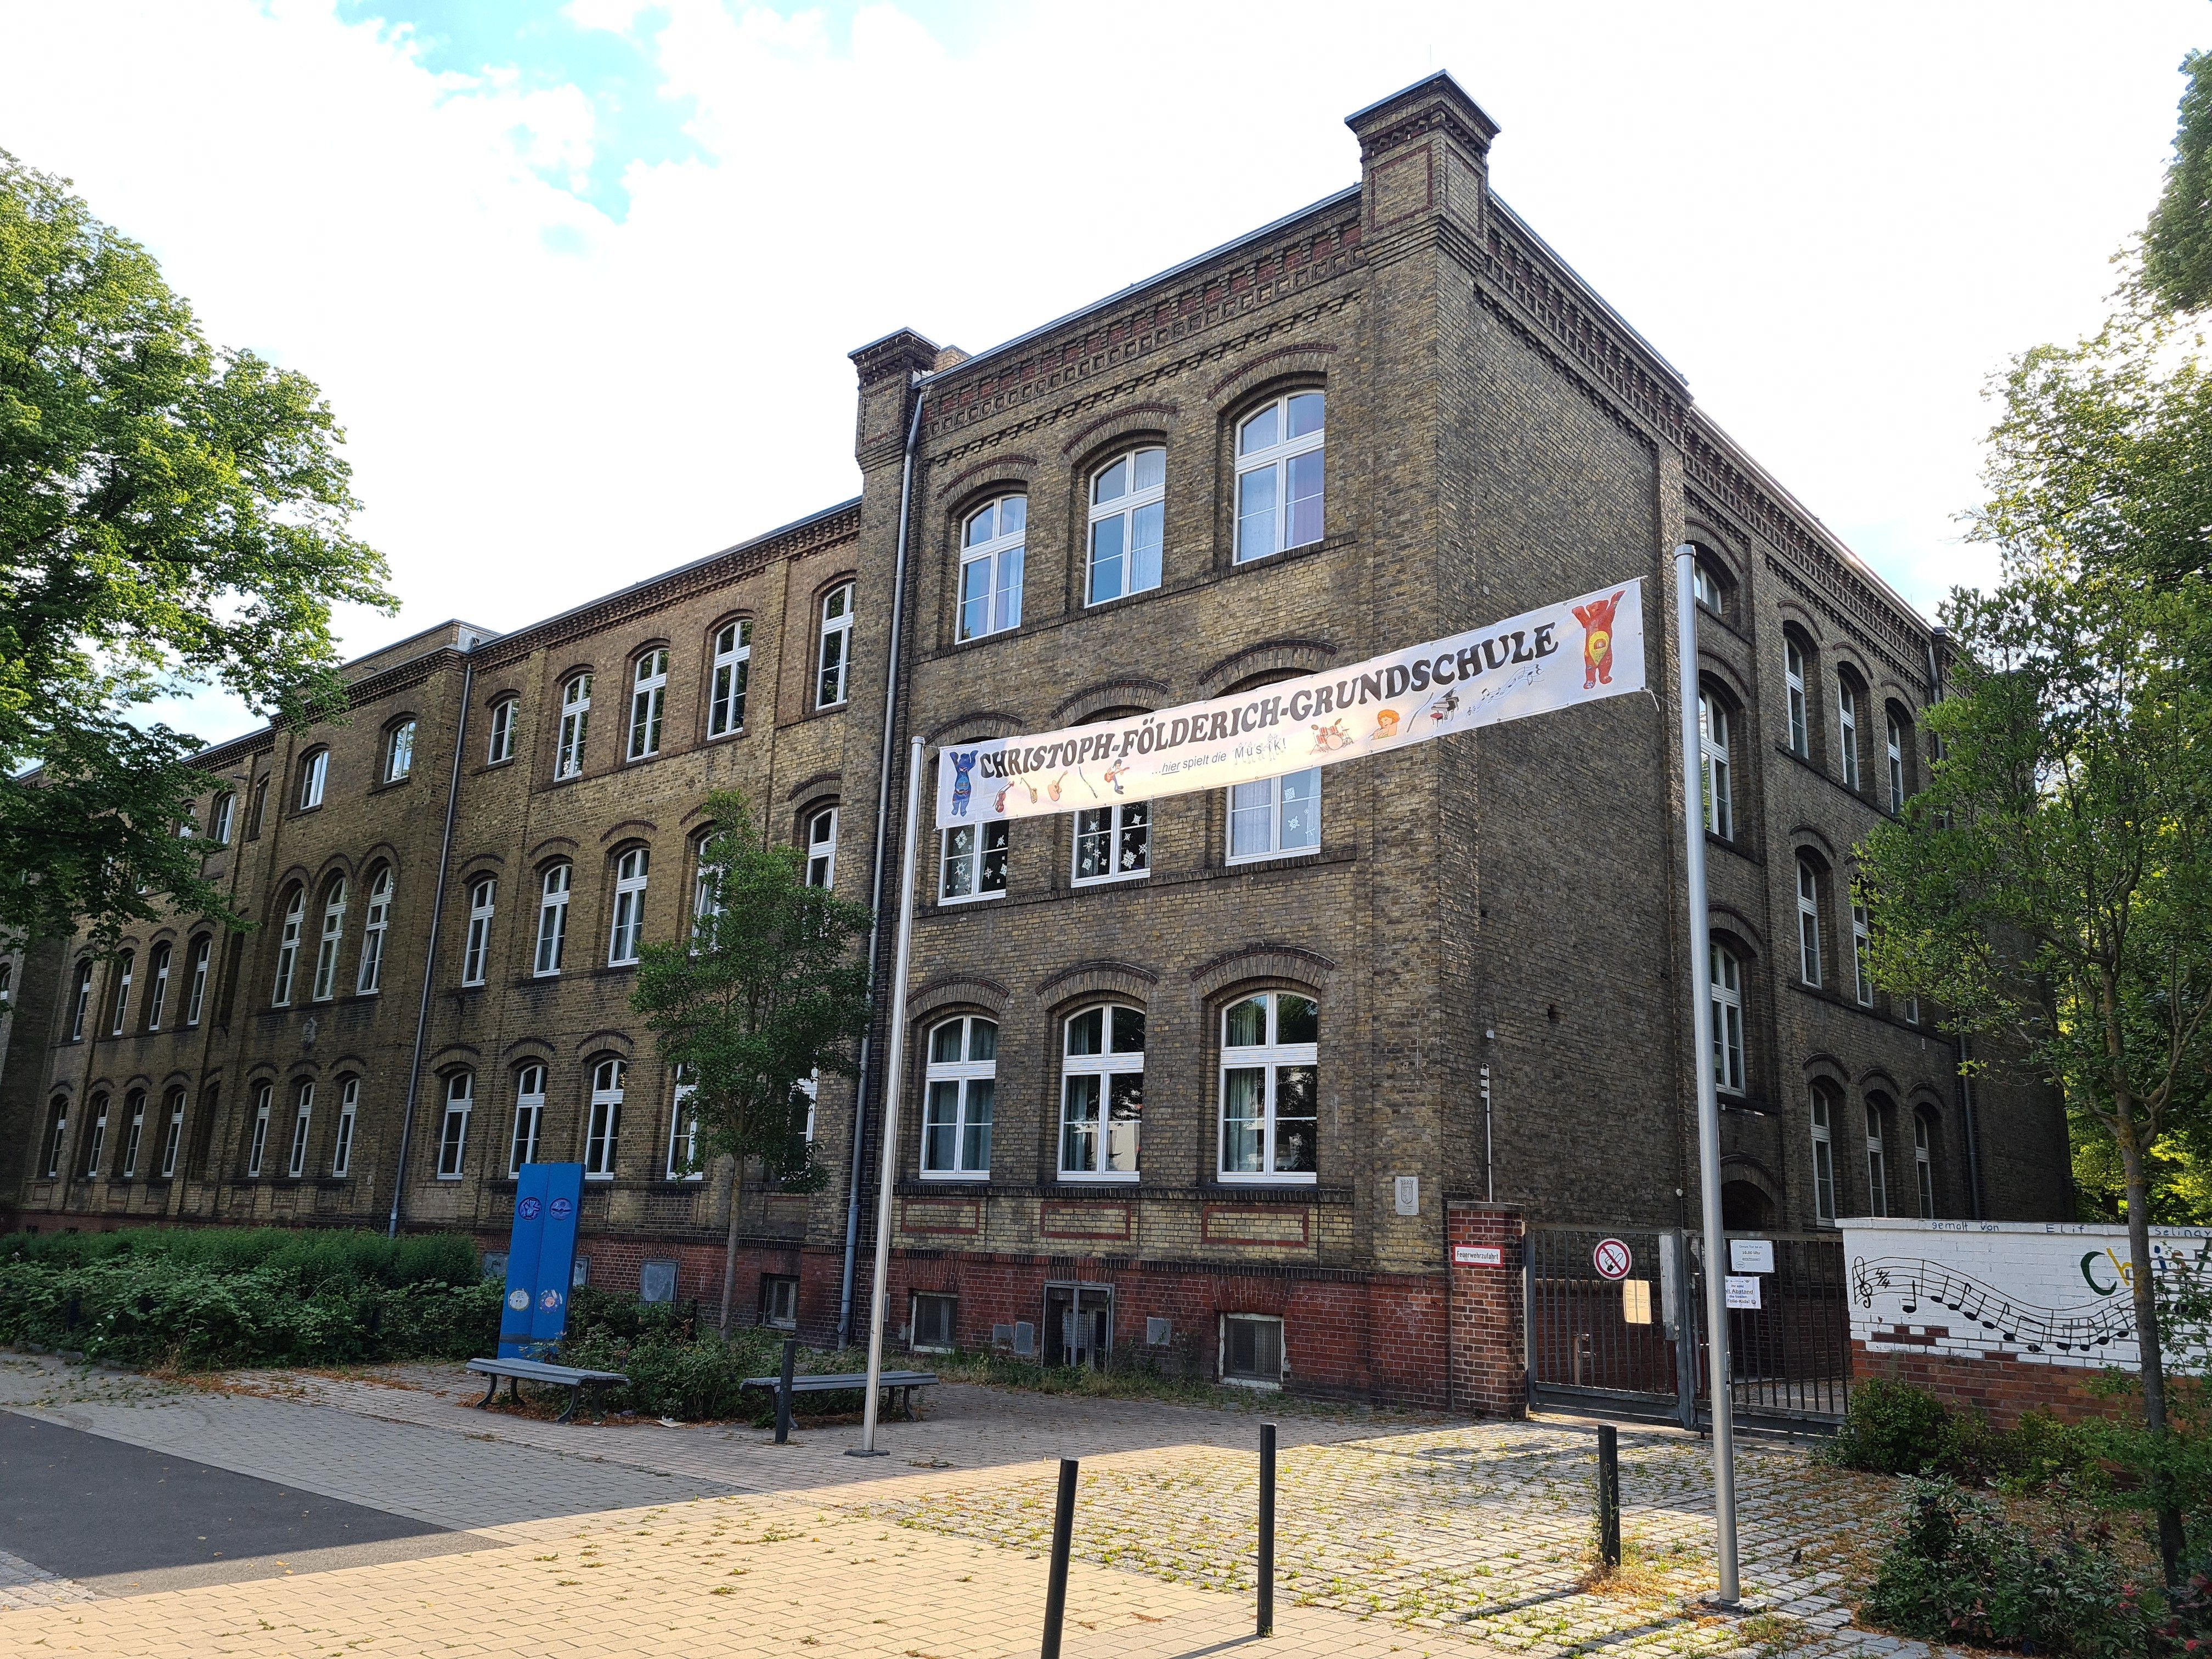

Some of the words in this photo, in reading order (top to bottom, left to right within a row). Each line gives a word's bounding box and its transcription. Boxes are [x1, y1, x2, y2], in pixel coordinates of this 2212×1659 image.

[980, 622, 1559, 778] CHRISTOPH-FÖLDERICH-GRUNDSCHULE
[1182, 754, 1209, 770] spielt
[1211, 751, 1227, 763] die
[1932, 1221, 1968, 1232] gemalt
[1980, 1222, 1999, 1231] von
[1457, 1250, 1498, 1260] Feuerwehrzufahrt
